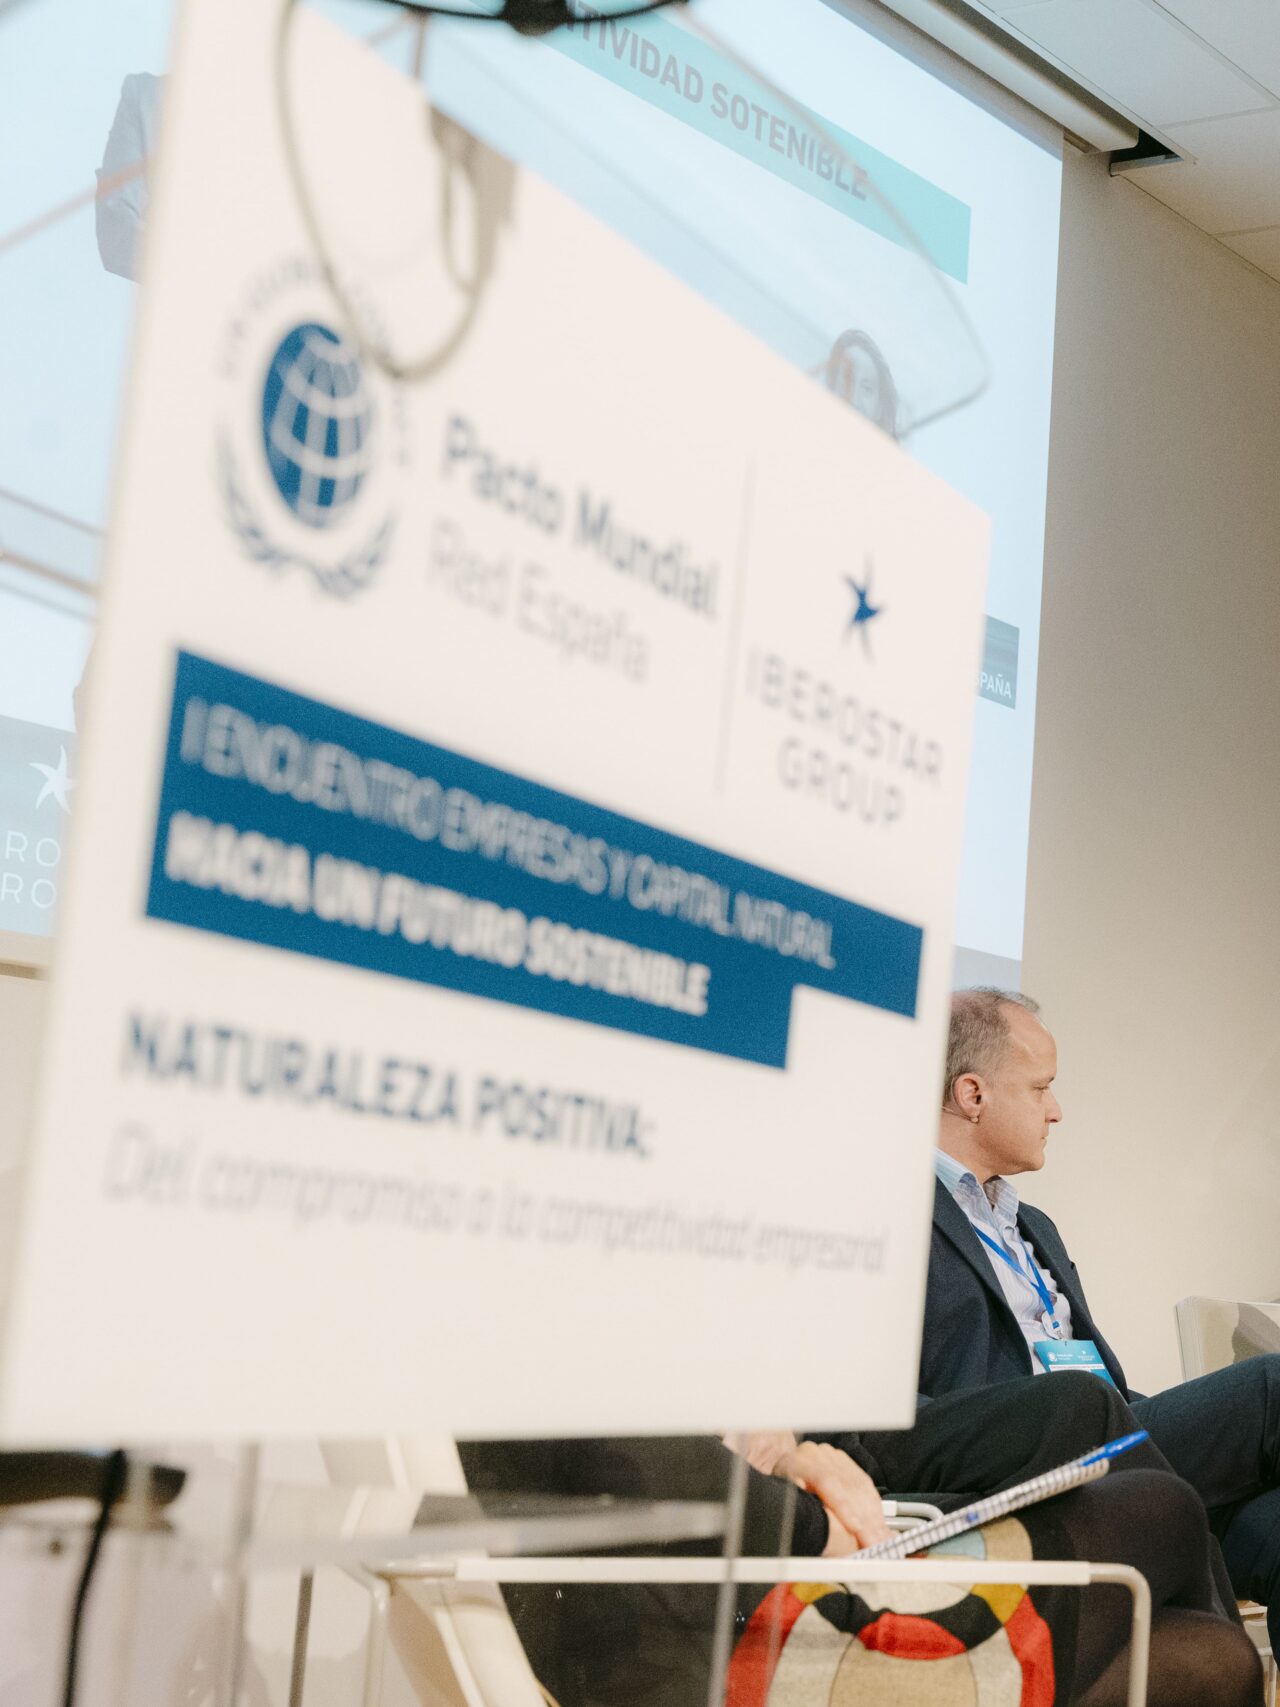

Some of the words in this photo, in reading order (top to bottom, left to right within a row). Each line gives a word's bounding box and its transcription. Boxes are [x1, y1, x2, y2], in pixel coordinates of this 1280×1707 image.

[710, 82, 869, 201] SOTENIBLE
[441, 411, 565, 536] Pacto
[573, 484, 721, 623] Mundial
[746, 645, 943, 789] IBEROSTAR
[777, 735, 906, 831] GROUP
[202, 701, 444, 842] ENCUENTRO
[439, 786, 609, 896] EMPRESAS
[627, 854, 735, 938] CAPITAL
[733, 889, 837, 970] NATURAL
[163, 809, 312, 915] HACIA
[312, 852, 381, 932] UN
[376, 871, 528, 969] FUTURO
[525, 915, 712, 1018] SOSTENIBLE
[119, 1008, 463, 1130] NATURALEZA
